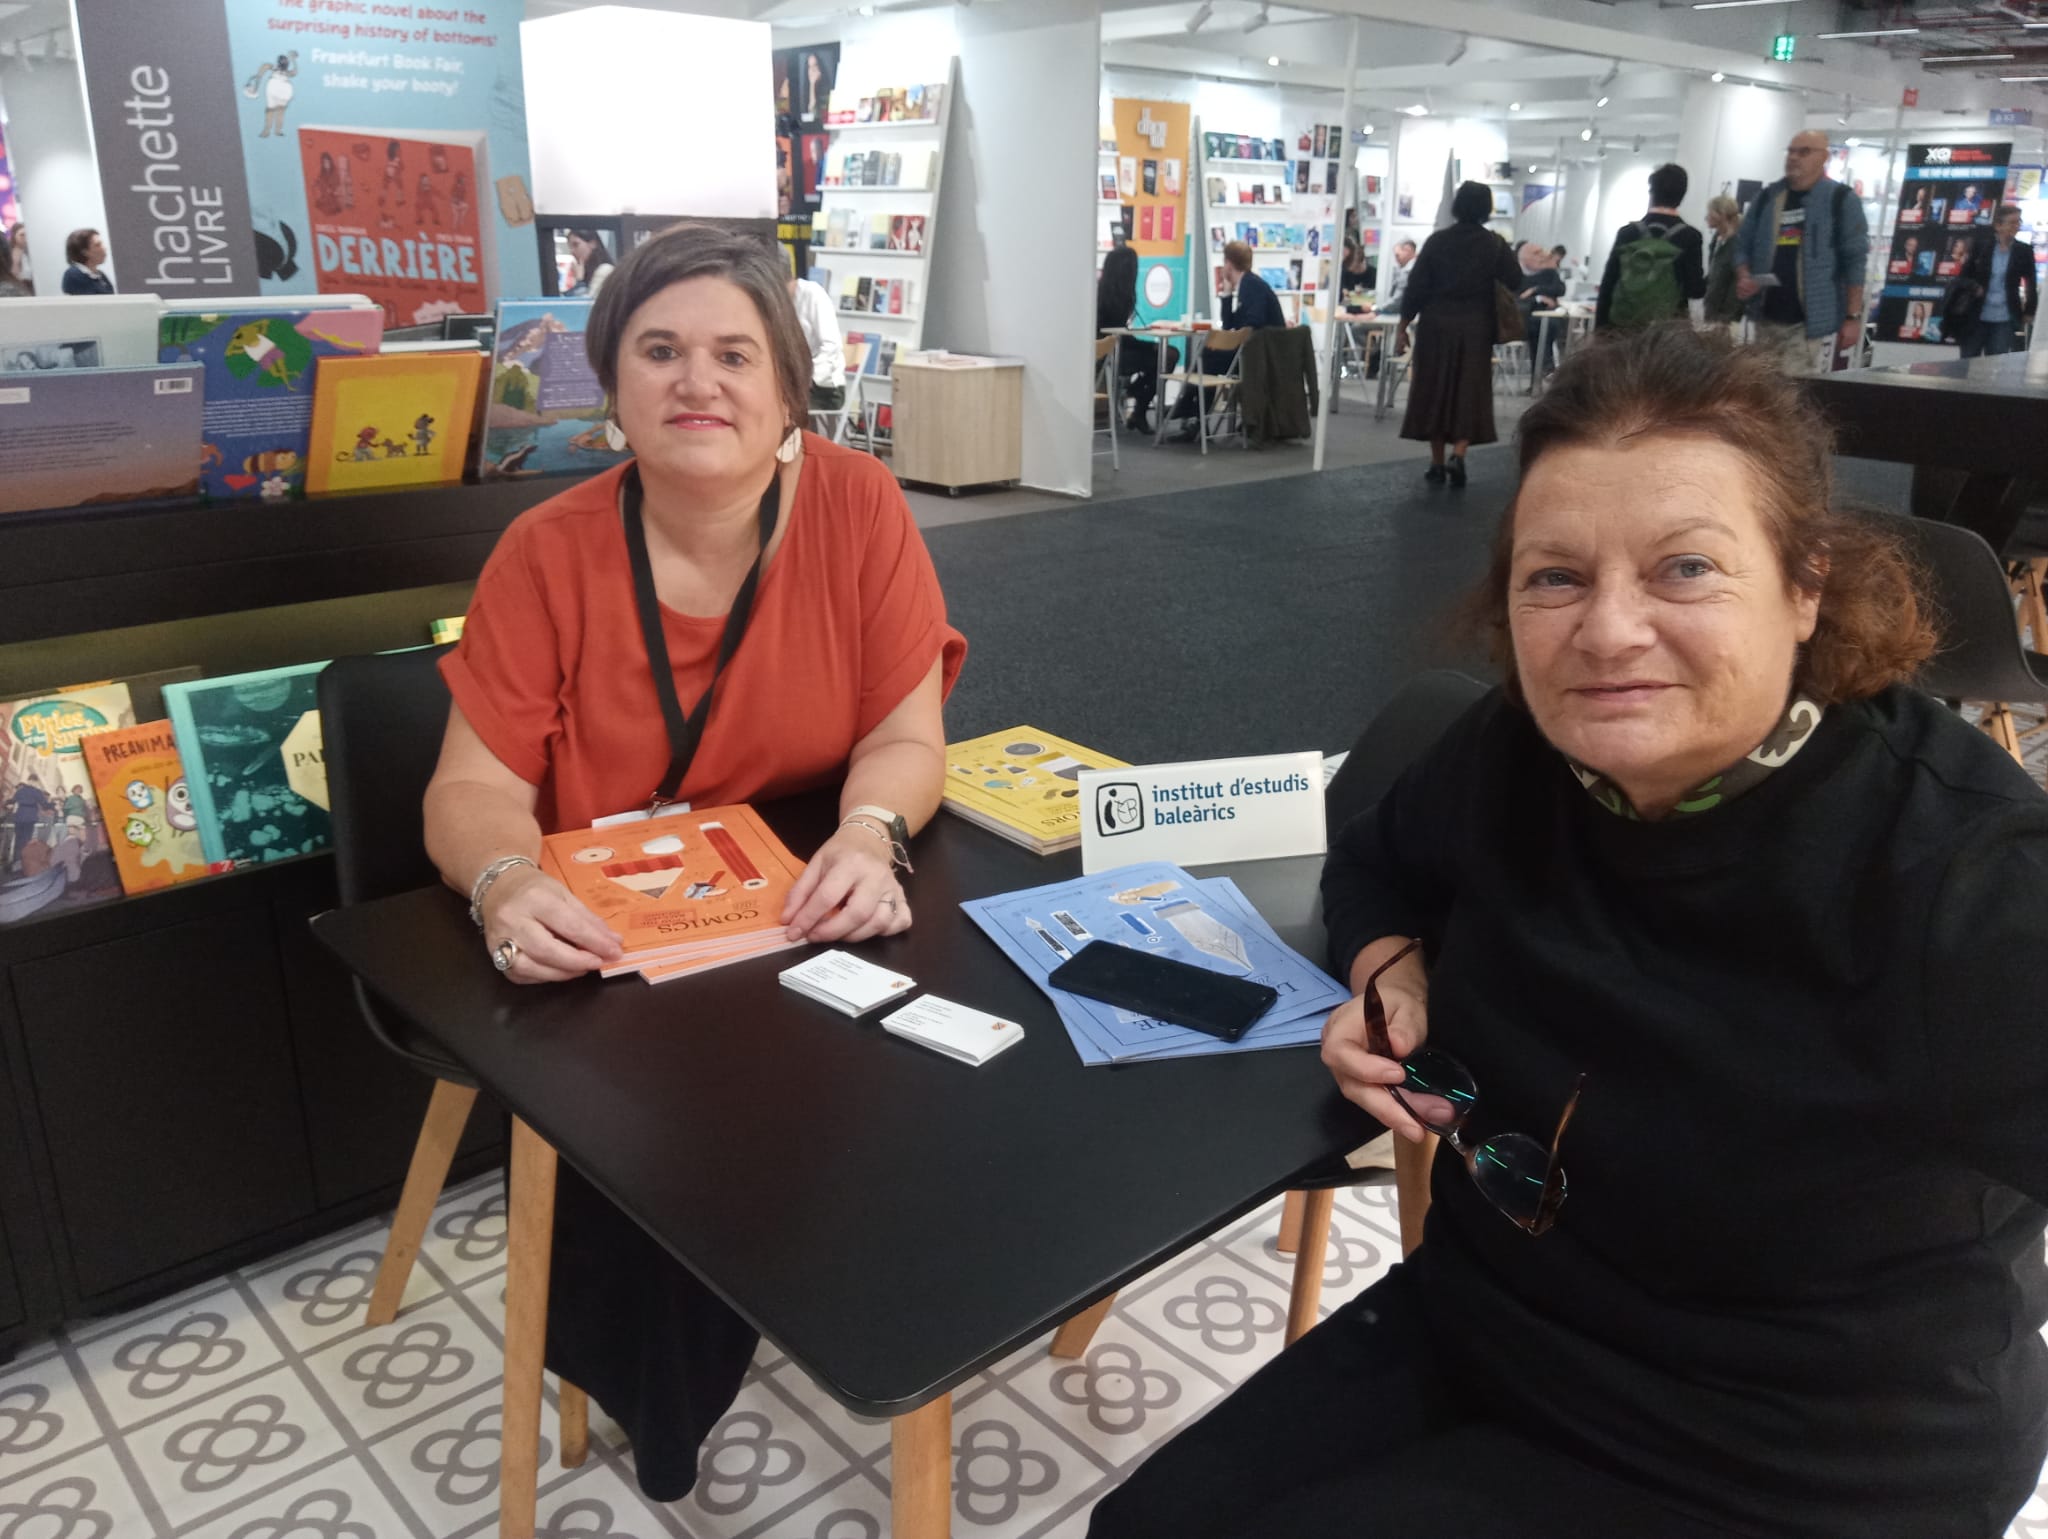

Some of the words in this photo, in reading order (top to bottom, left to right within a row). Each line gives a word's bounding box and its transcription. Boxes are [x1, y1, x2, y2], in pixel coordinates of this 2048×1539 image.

[371, 4, 412, 18] novel
[416, 7, 459, 21] about
[463, 9, 486, 23] the
[267, 17, 350, 39] surprising
[353, 23, 409, 42] history
[413, 27, 429, 42] of
[311, 48, 389, 67] Frankfurt
[393, 54, 432, 70] Book
[322, 73, 368, 89] shake
[371, 78, 408, 93] your
[124, 65, 196, 284] hachette
[190, 186, 233, 284] LIVRE
[317, 231, 478, 283] DERRIÈRE
[1152, 782, 1224, 803] institut
[1230, 773, 1309, 796] d'estudis
[1041, 811, 1080, 827] ORS
[1155, 803, 1235, 826] baleàrics
[658, 909, 758, 934] COMICS
